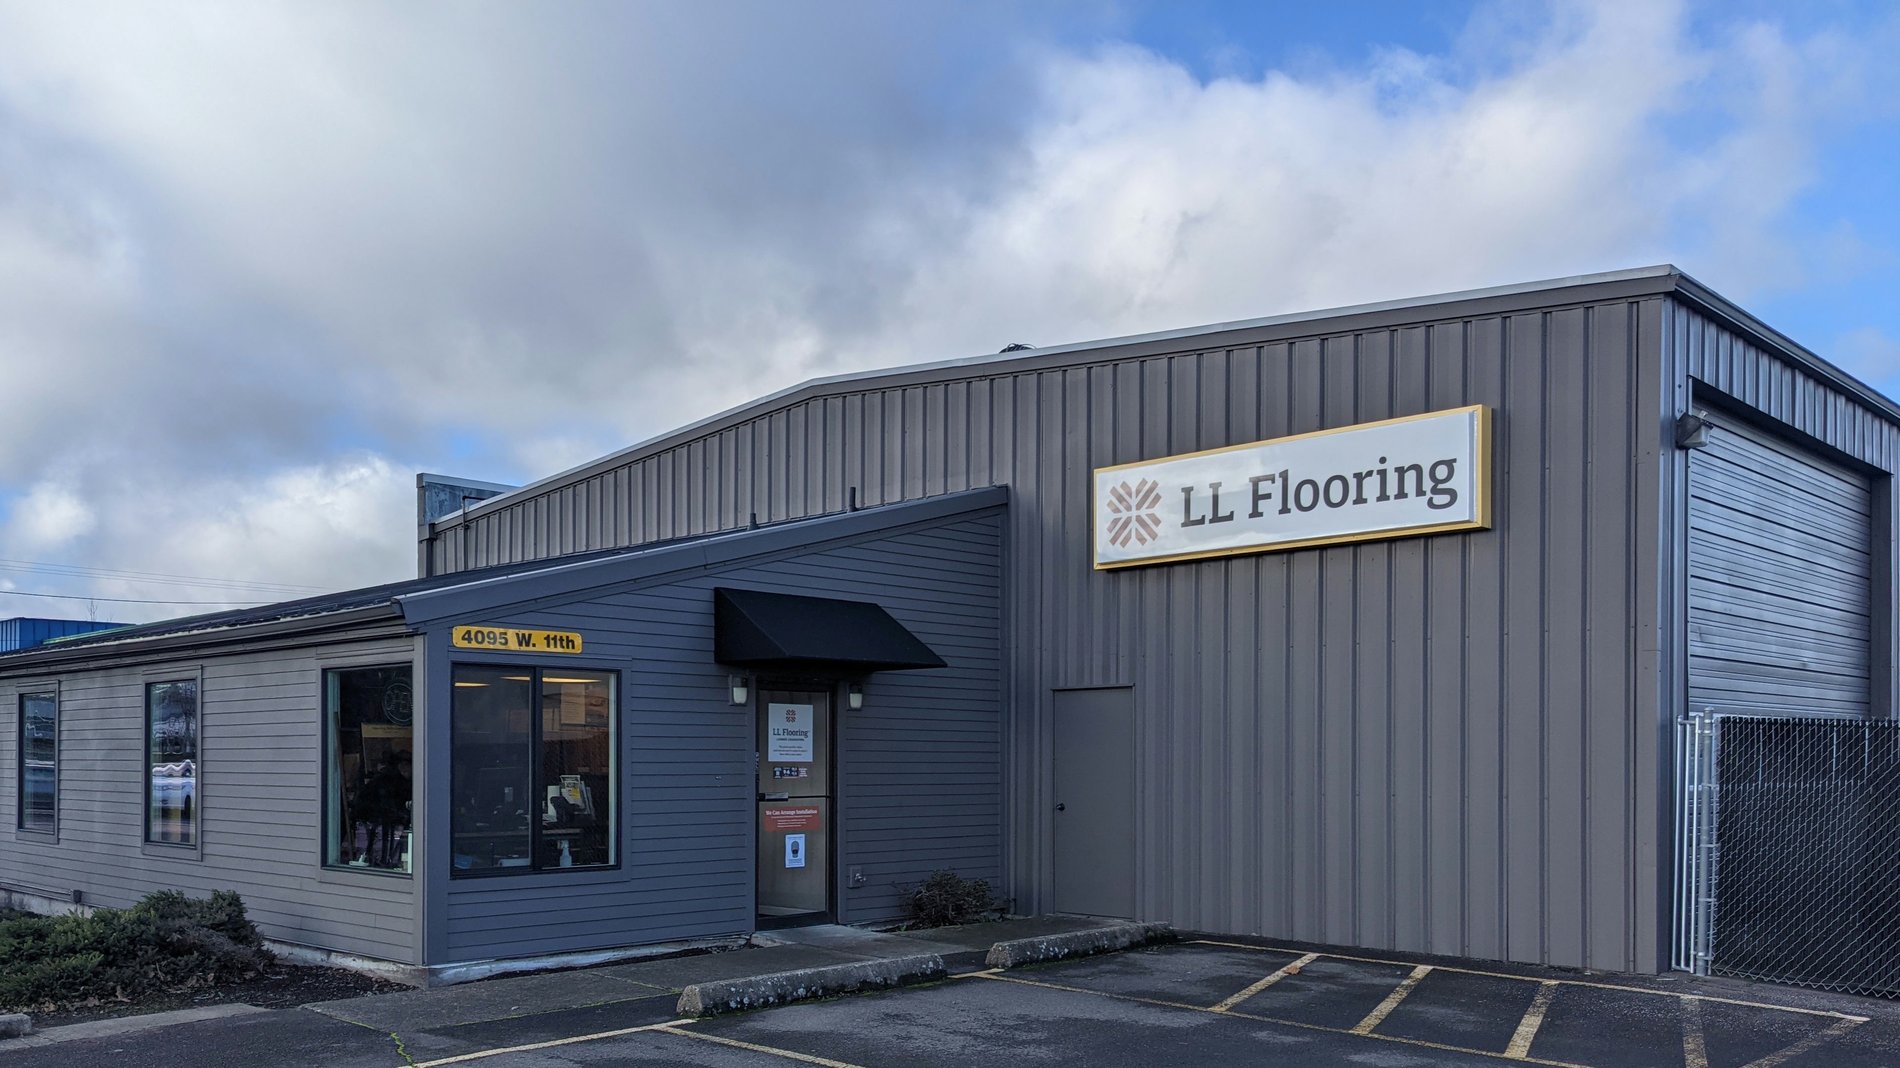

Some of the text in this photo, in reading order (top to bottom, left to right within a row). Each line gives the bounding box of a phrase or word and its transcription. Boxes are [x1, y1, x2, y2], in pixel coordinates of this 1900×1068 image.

[1181, 456, 1458, 528] LL Flooring
[461, 630, 576, 650] 4095 W. 11th
[773, 728, 809, 738] LL Flooring
